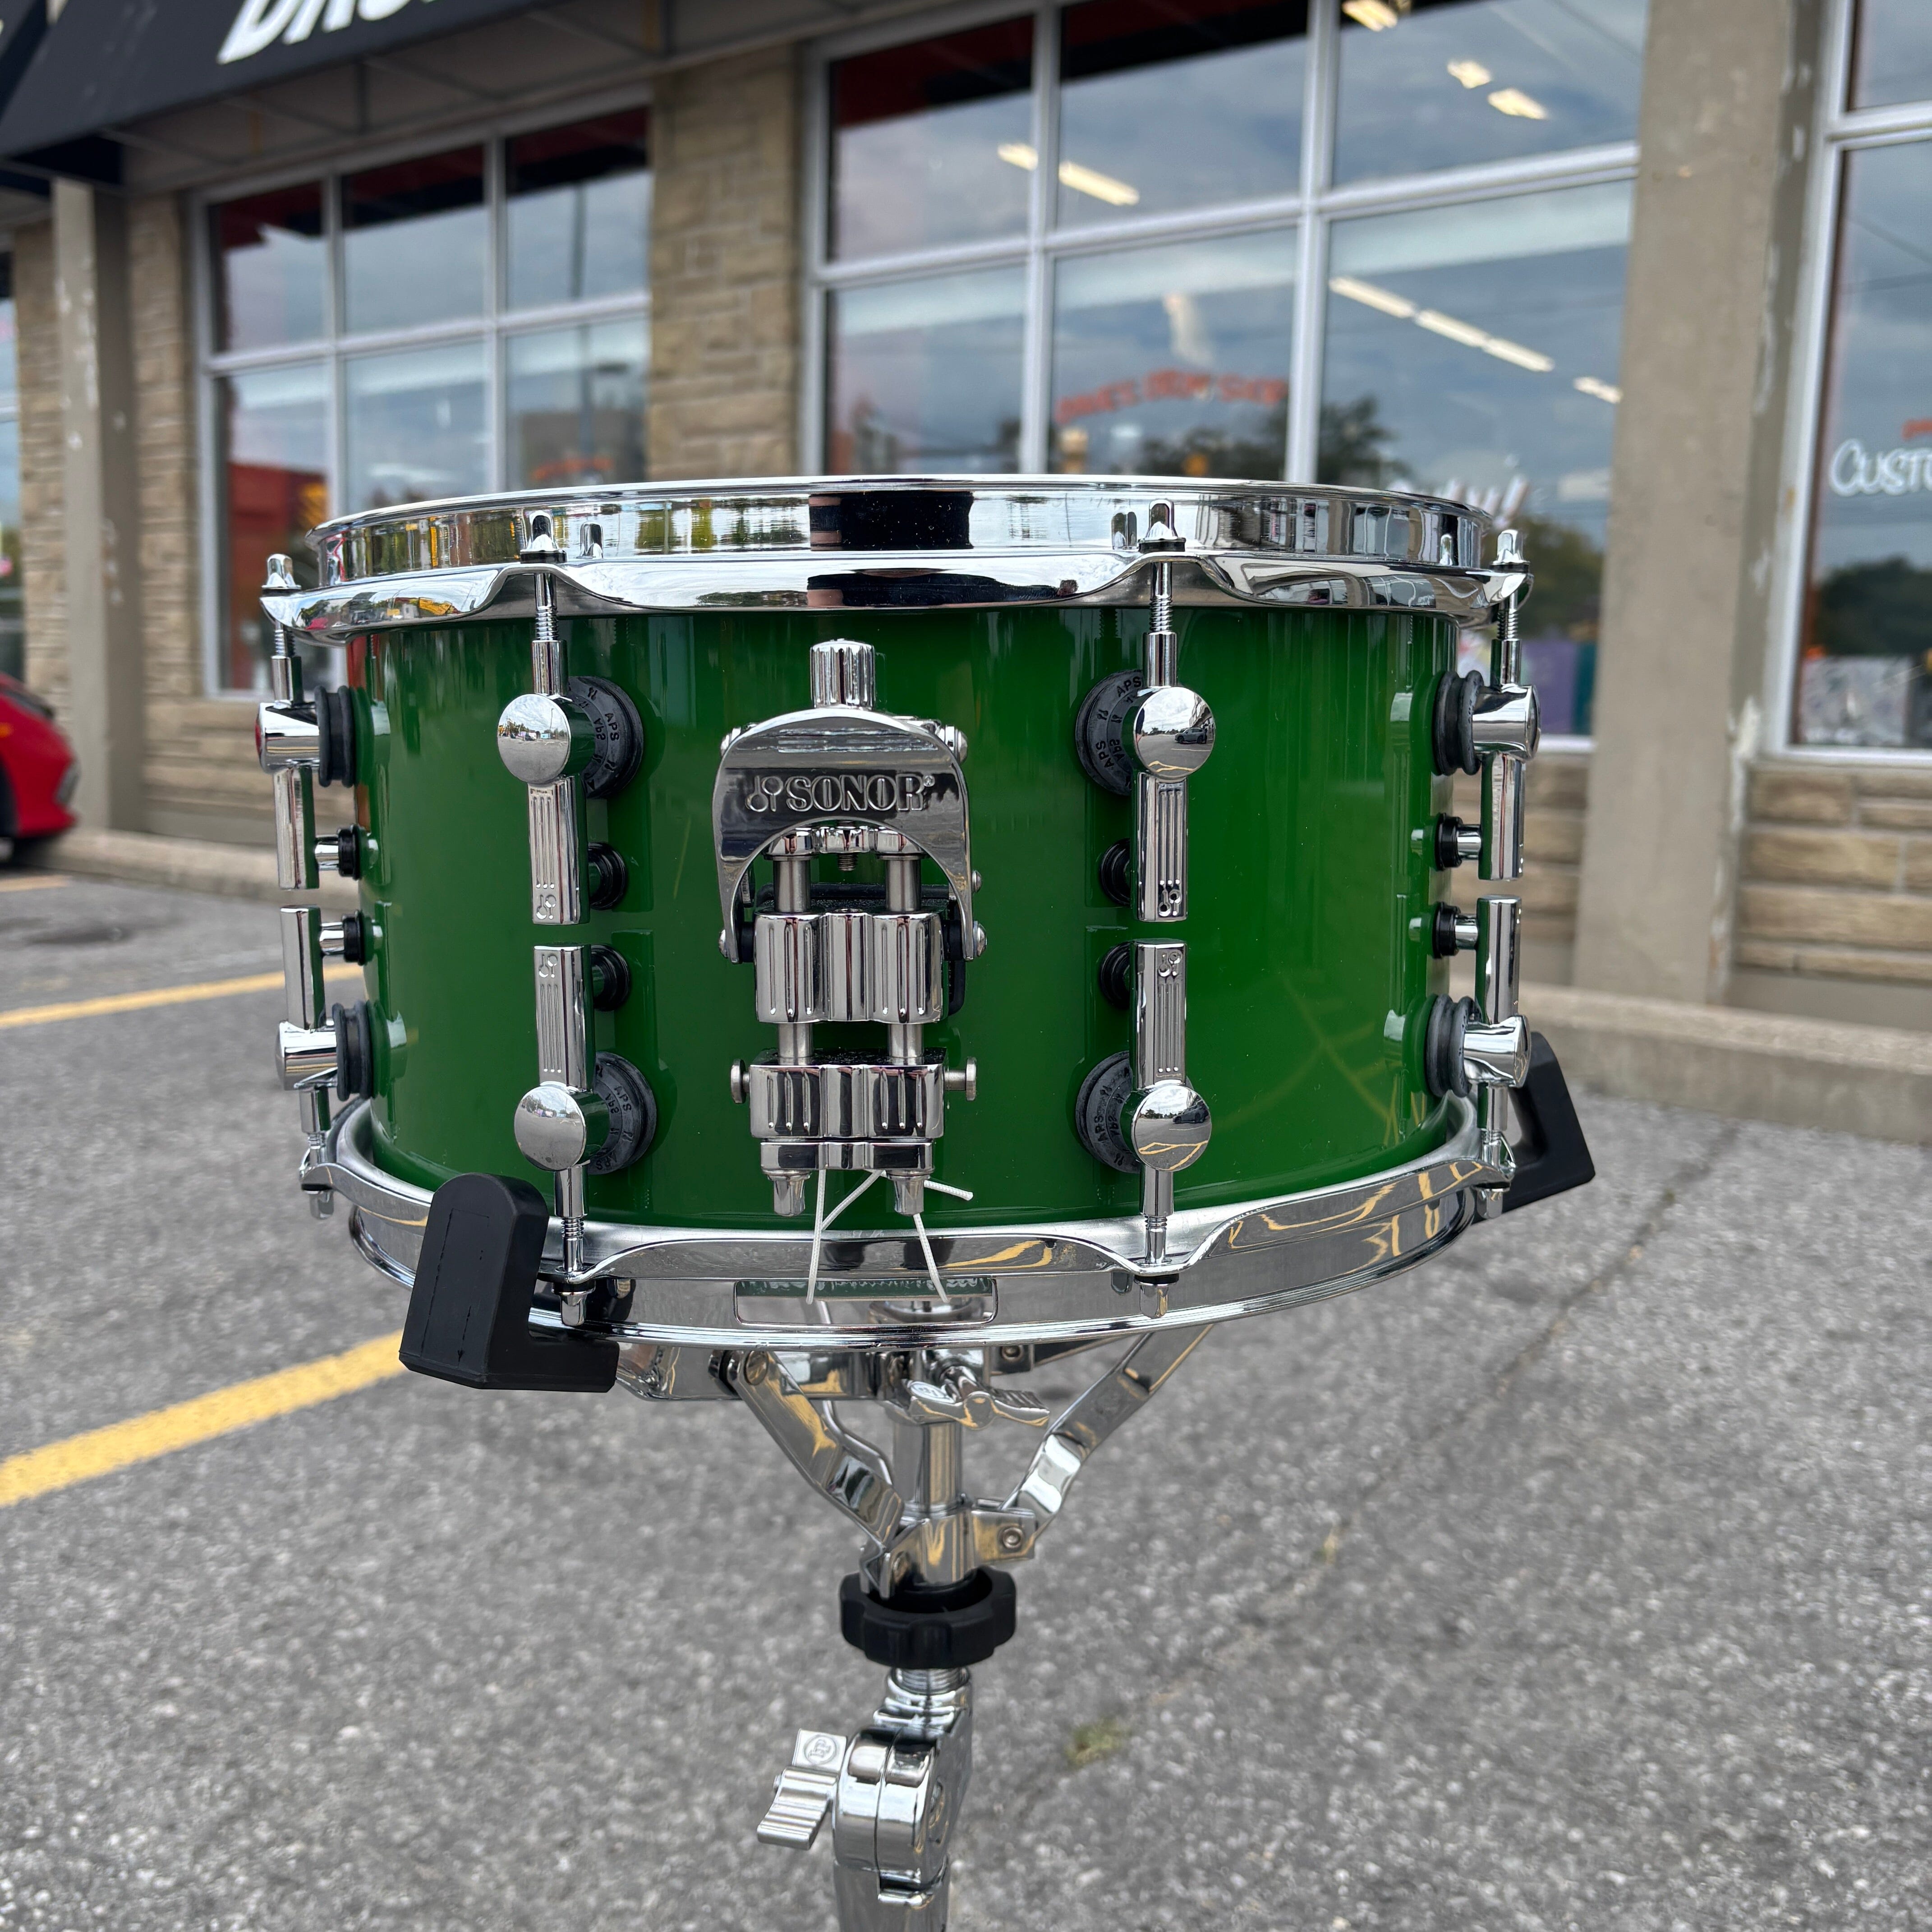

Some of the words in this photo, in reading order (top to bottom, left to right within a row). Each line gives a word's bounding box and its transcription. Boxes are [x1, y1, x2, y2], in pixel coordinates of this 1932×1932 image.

[1117, 676, 1142, 697] APS
[605, 713, 620, 741] APS
[1096, 740, 1114, 768] APS
[614, 1086, 632, 1112] APS
[1094, 1115, 1108, 1143] APS
